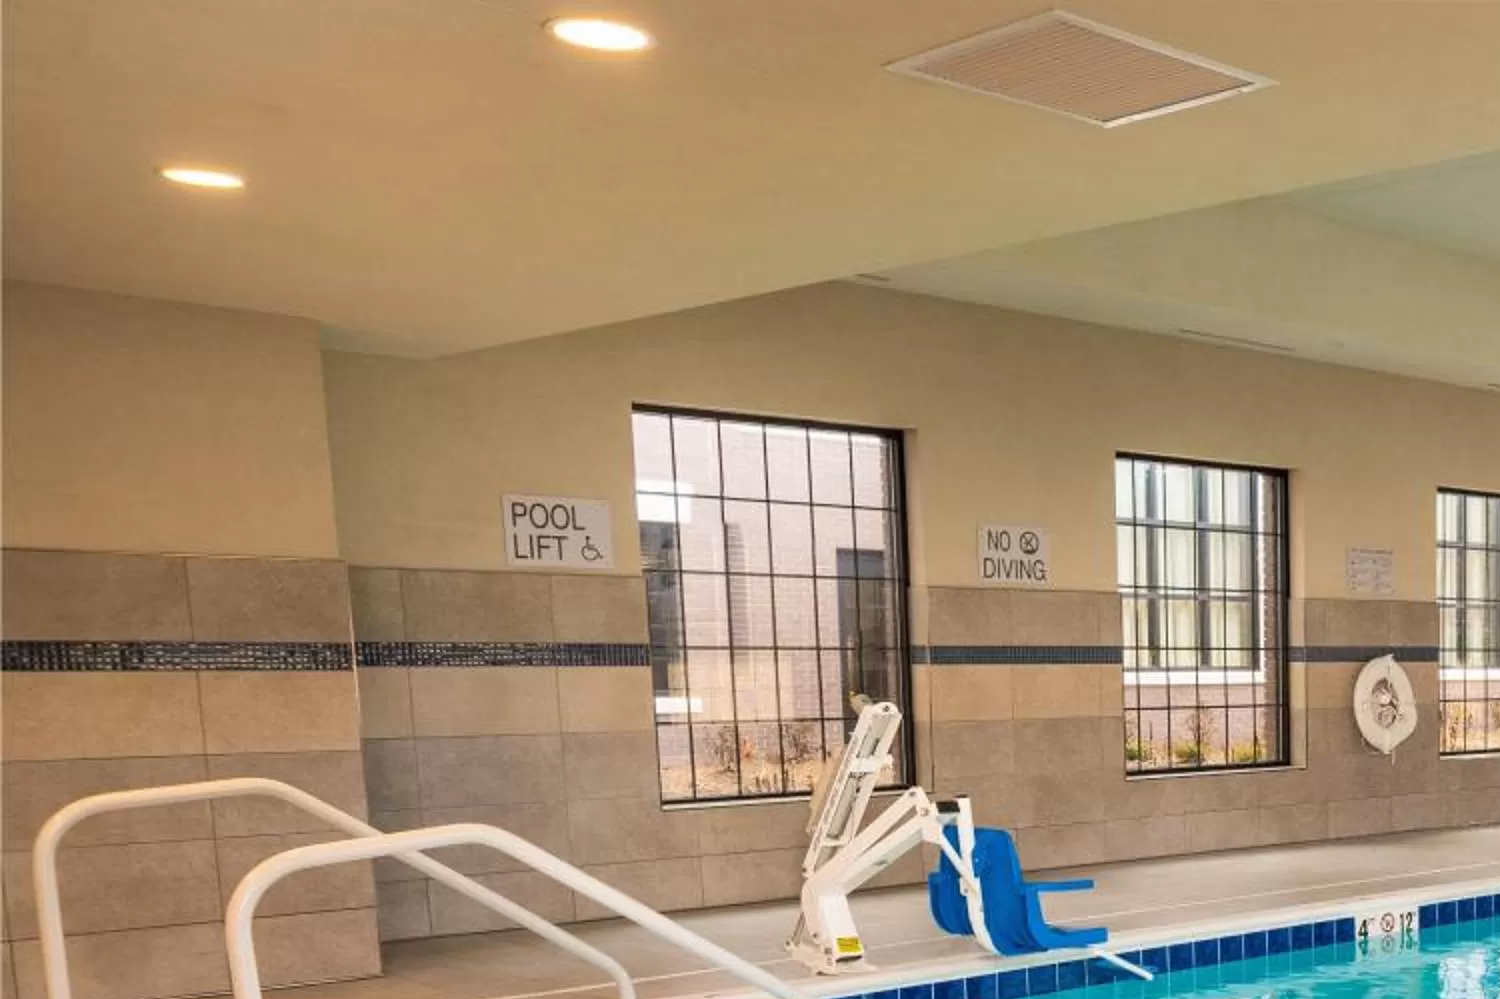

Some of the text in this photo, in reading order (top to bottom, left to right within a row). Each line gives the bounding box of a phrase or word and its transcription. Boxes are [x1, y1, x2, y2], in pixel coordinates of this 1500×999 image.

[511, 502, 586, 530] POOL
[513, 533, 568, 560] LIFT
[987, 528, 1011, 552] NO
[983, 557, 1048, 581] DIVING
